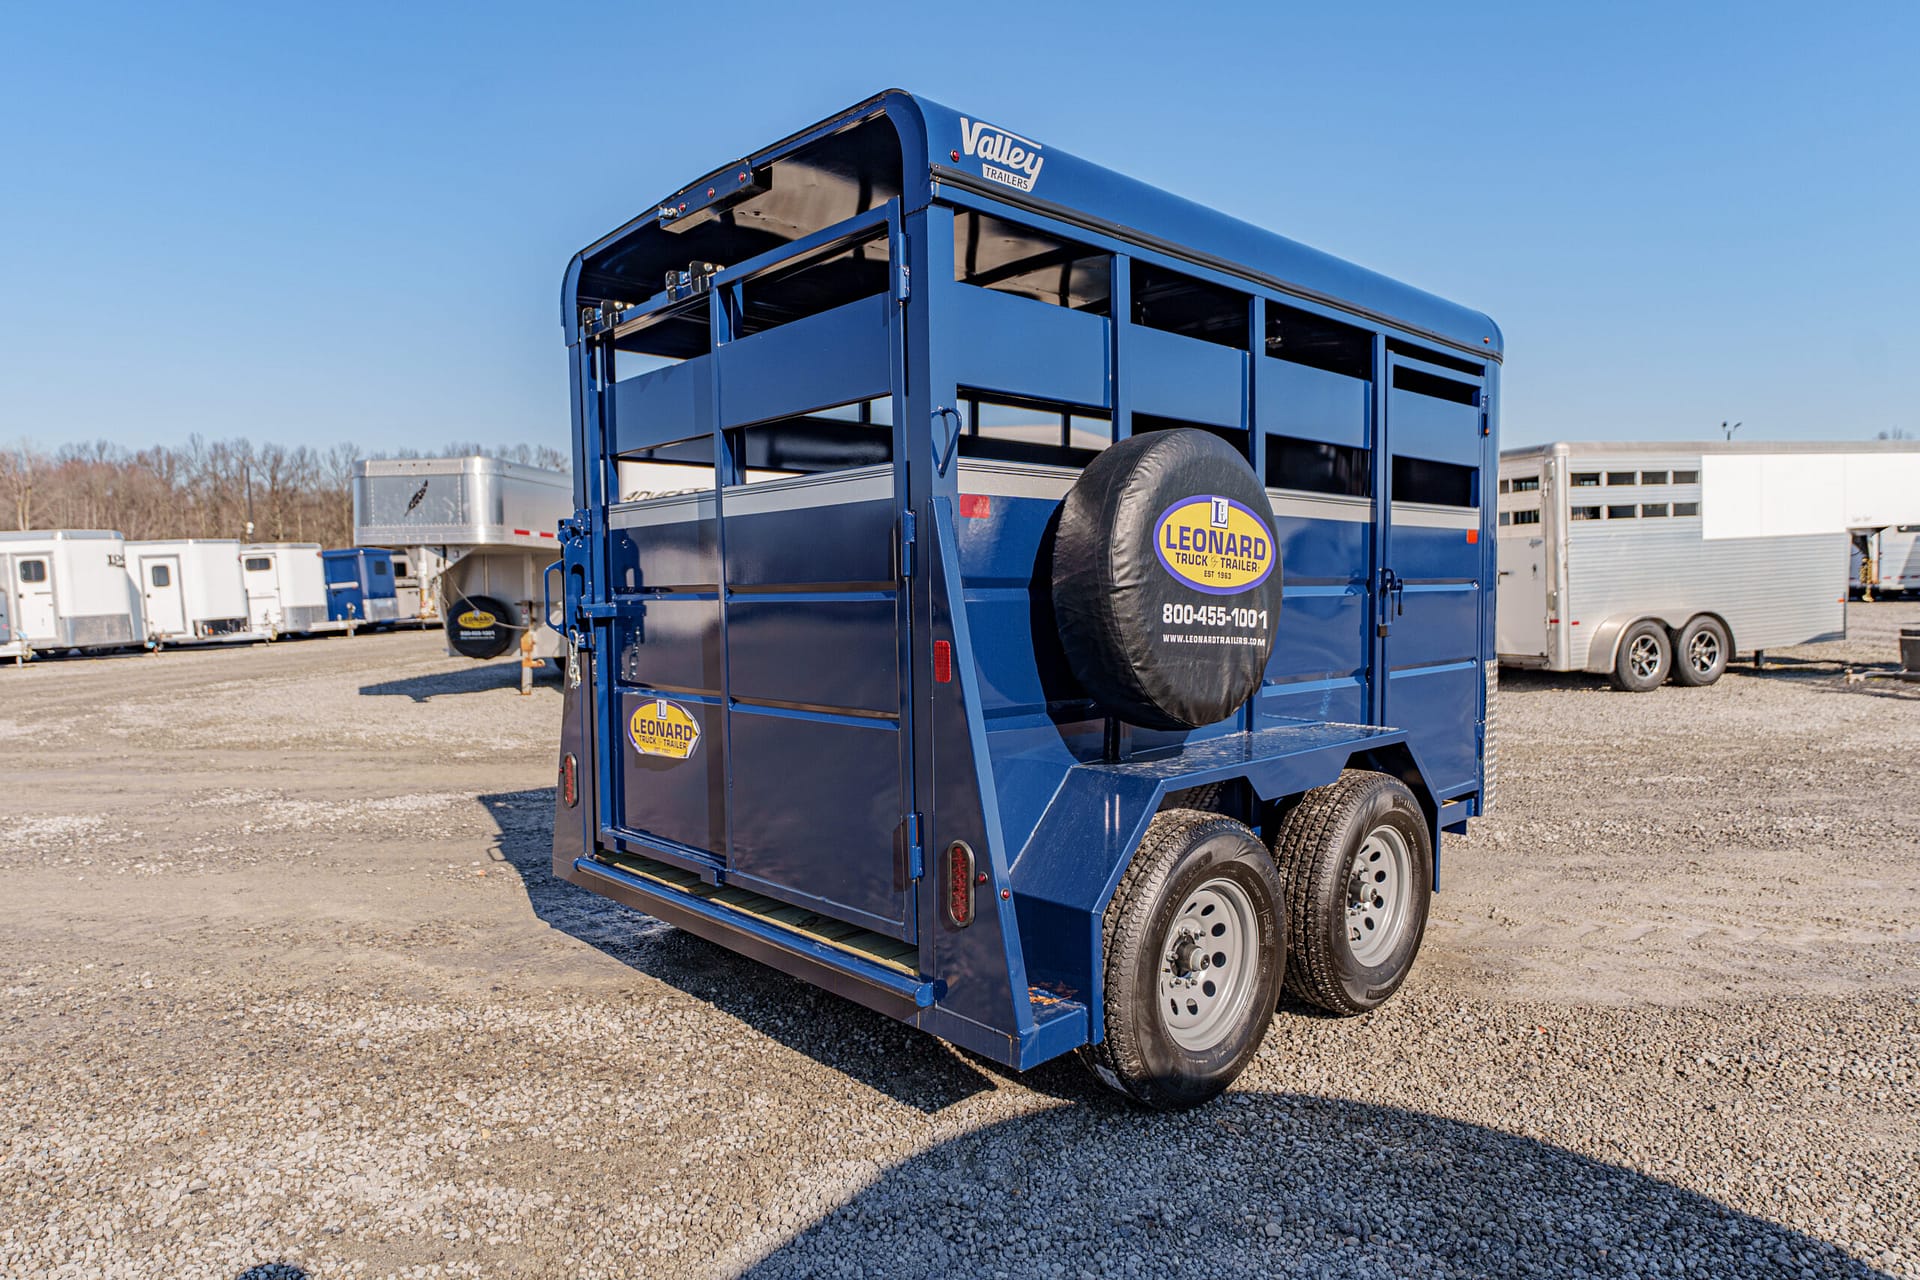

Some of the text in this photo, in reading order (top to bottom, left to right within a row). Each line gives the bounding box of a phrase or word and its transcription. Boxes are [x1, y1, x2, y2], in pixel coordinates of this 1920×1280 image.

[960, 117, 1044, 186] Valley
[985, 166, 1028, 190] TRAILERS
[1166, 524, 1266, 561] LEONARD
[1175, 552, 1208, 567] TRUCK
[1220, 557, 1258, 573] TRAILER
[1204, 570, 1214, 578] EST
[1162, 603, 1267, 630] 800-455-1001
[1162, 633, 1266, 647] WWW.LEONARDTRAILERS.COM
[633, 718, 693, 741] LEONARD
[639, 735, 687, 749] TRUCK TRAILER
